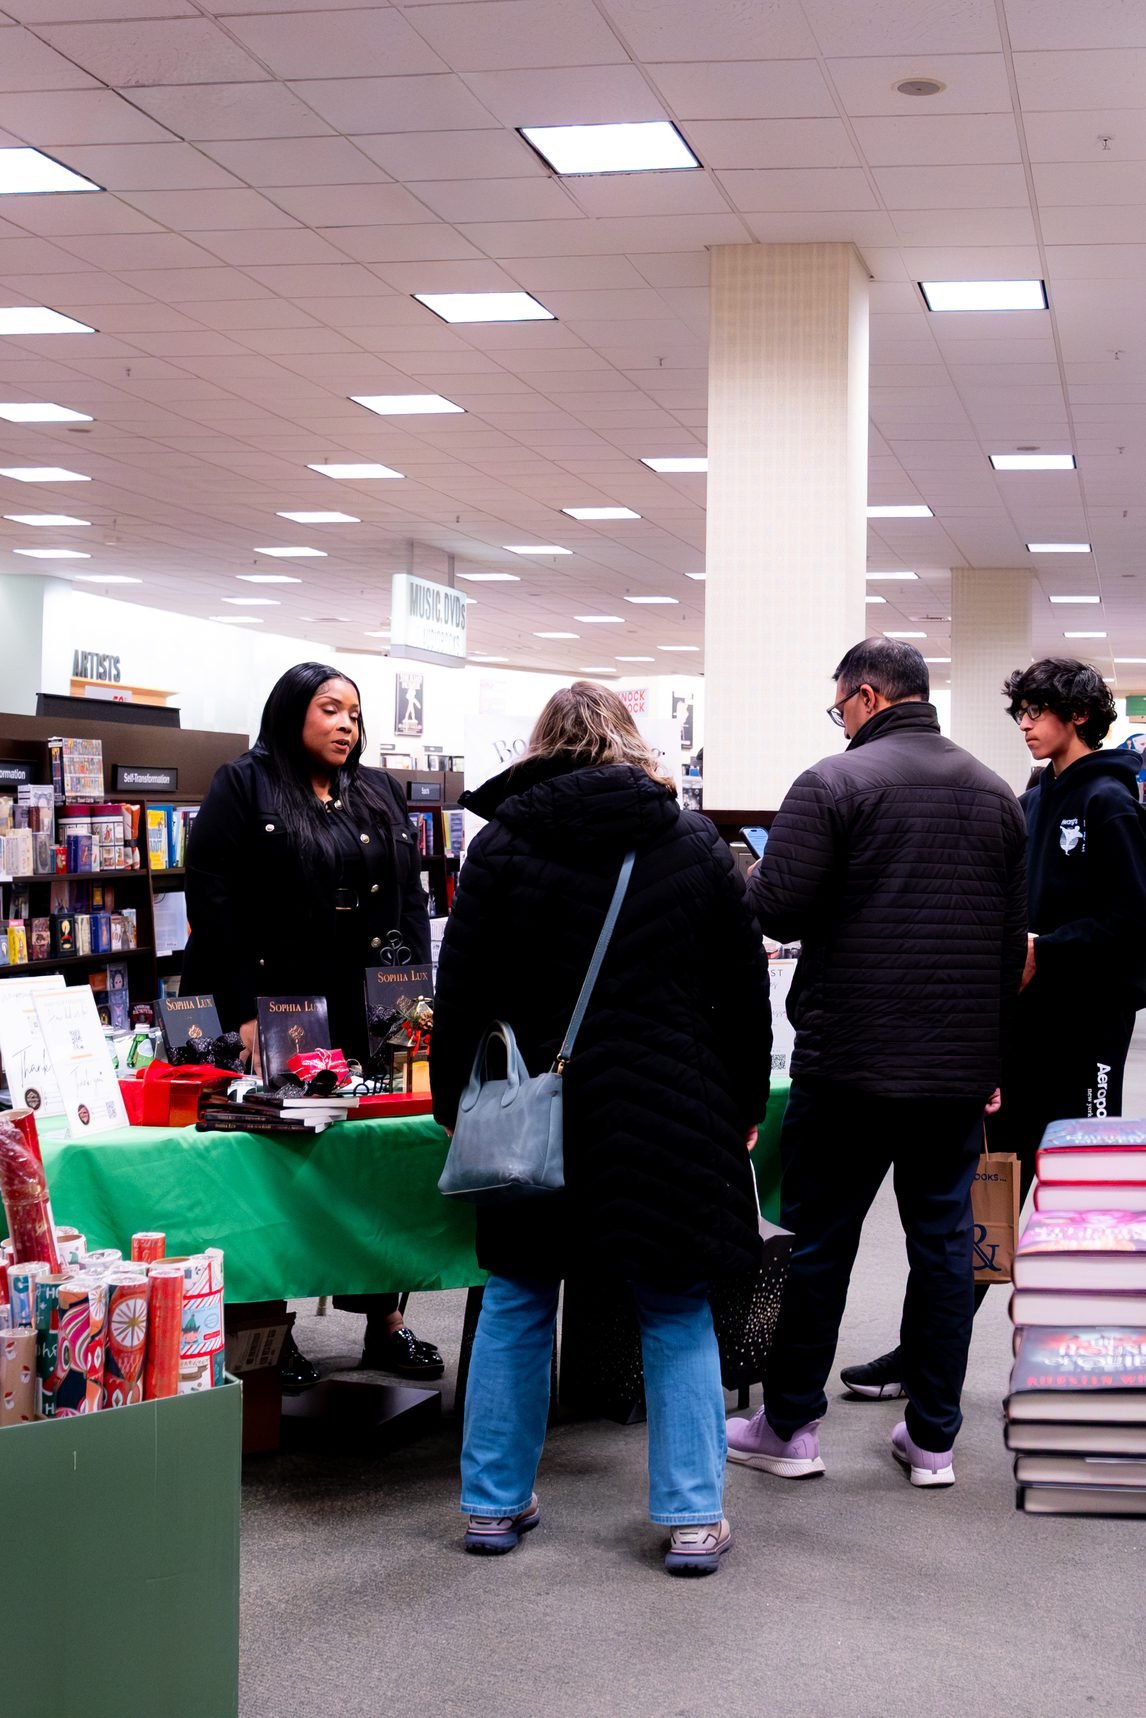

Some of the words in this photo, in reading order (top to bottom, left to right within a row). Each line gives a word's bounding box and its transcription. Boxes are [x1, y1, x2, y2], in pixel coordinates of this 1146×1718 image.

[72, 649, 121, 683] ARTISTS
[619, 690, 645, 702] NOCK
[628, 703, 645, 714] OCK
[123, 772, 171, 785] Self-Transformation
[377, 971, 409, 984] SOPHIA
[411, 970, 429, 981] LUX
[165, 998, 195, 1011] SOPHIA
[195, 996, 213, 1009] LUX
[268, 1001, 302, 1013] SOPHIA
[974, 1173, 1007, 1182] OOKS...
